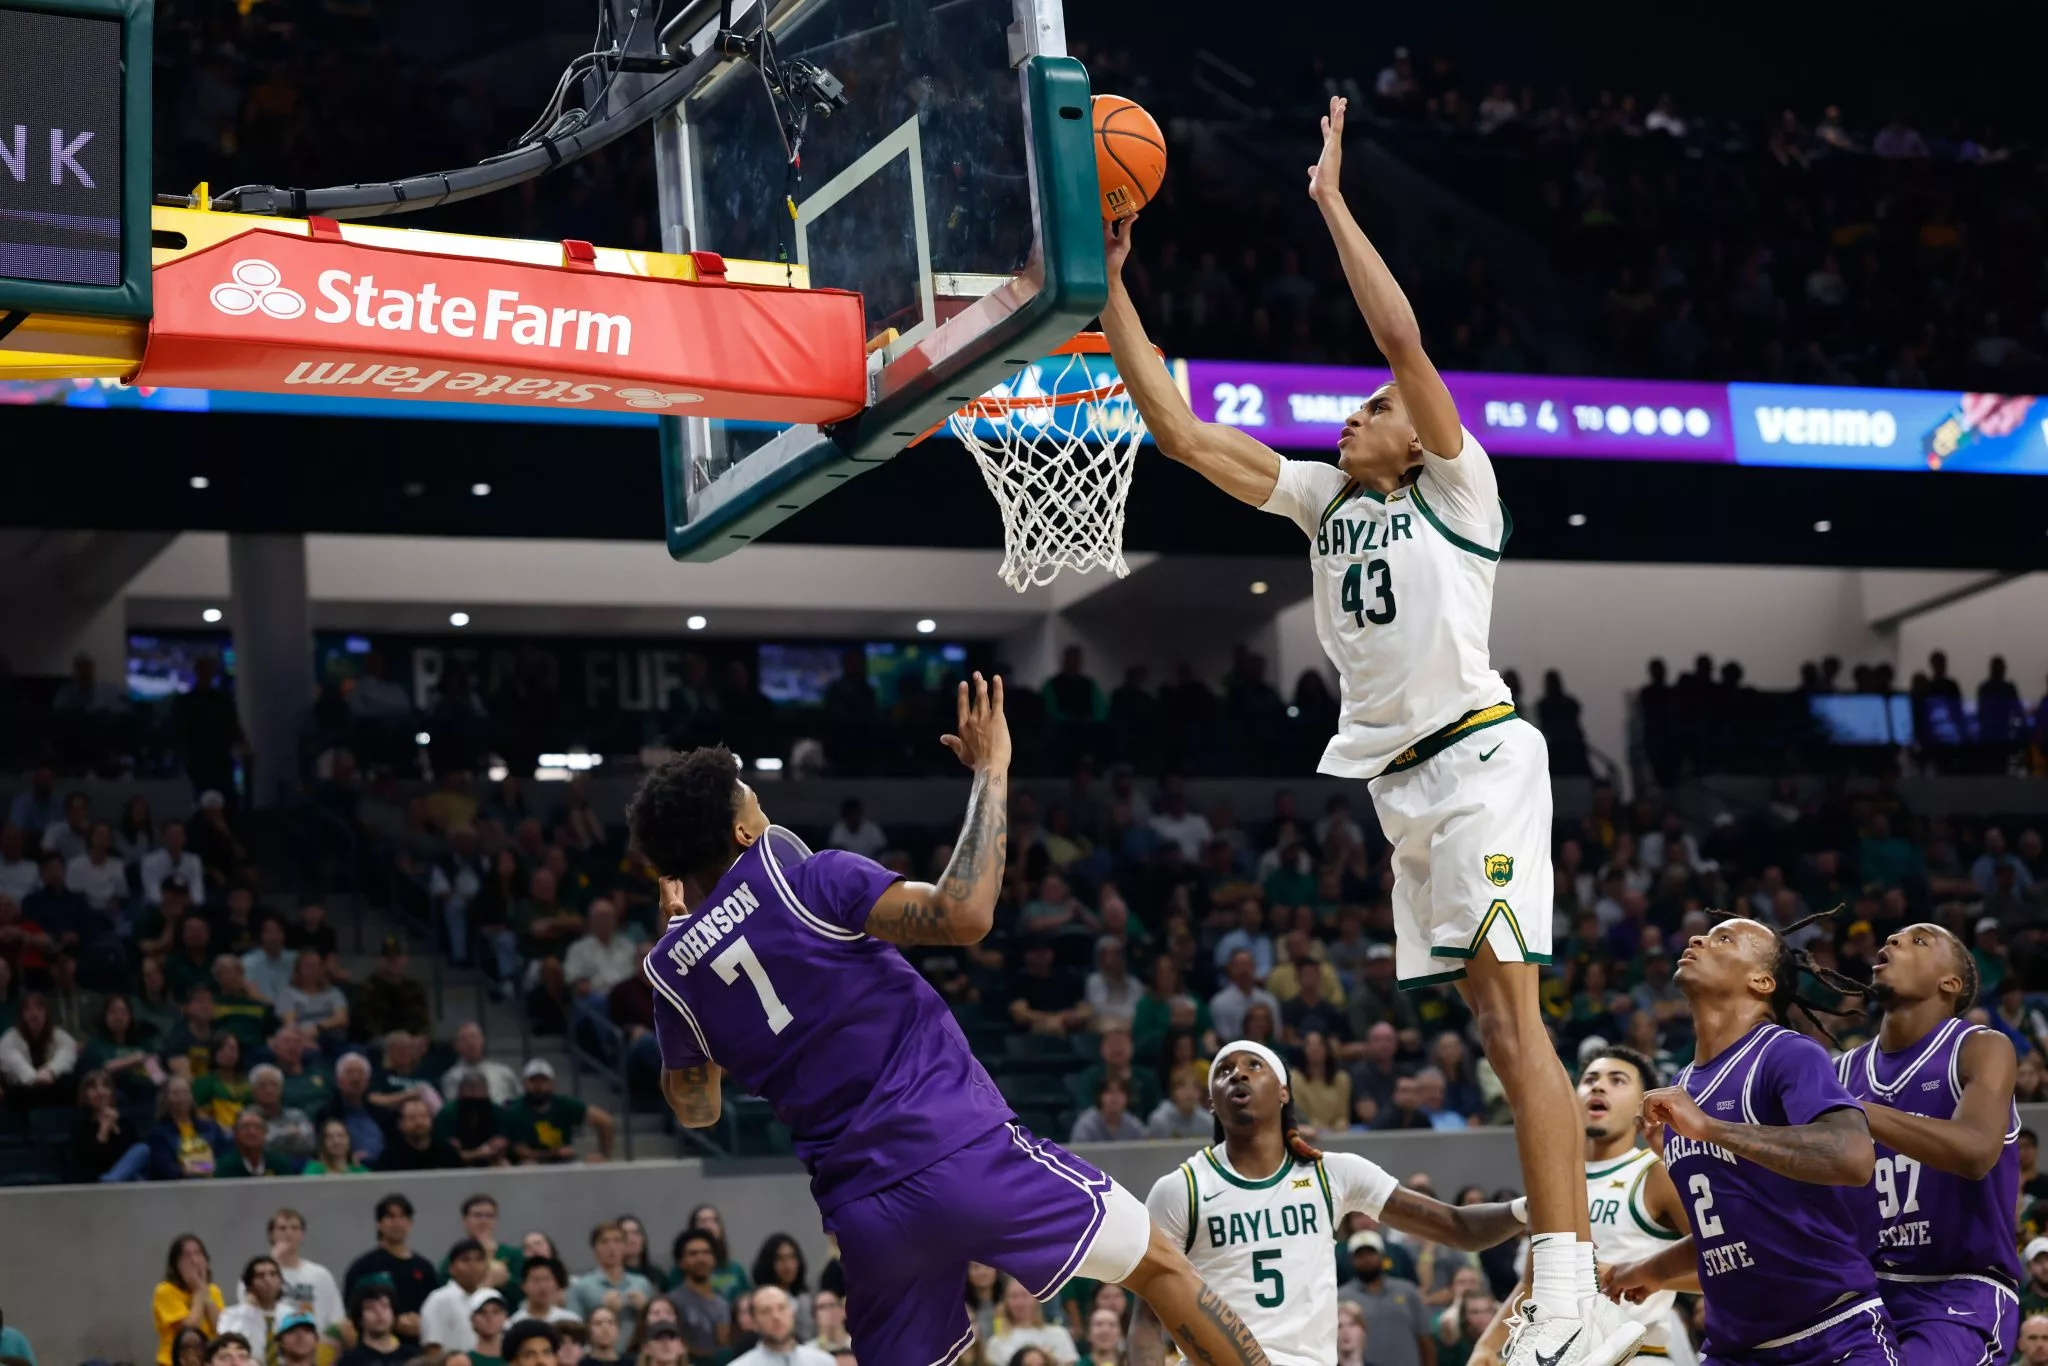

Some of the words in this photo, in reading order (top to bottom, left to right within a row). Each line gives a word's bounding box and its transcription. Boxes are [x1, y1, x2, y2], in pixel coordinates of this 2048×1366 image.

[1213, 382, 1266, 426] 22
[1754, 405, 1898, 448] venmo
[1341, 558, 1397, 629] 43
[667, 881, 760, 976] JOHNSON
[709, 935, 794, 1036] 7
[1663, 1135, 1738, 1172] ARLETON
[1688, 1173, 1725, 1239] 2
[1874, 1154, 1921, 1219] 97
[1207, 1203, 1319, 1248] BAYLOR
[1878, 1220, 1932, 1249] STATE
[1252, 1248, 1285, 1308] 5
[1702, 1240, 1755, 1278] STATE
